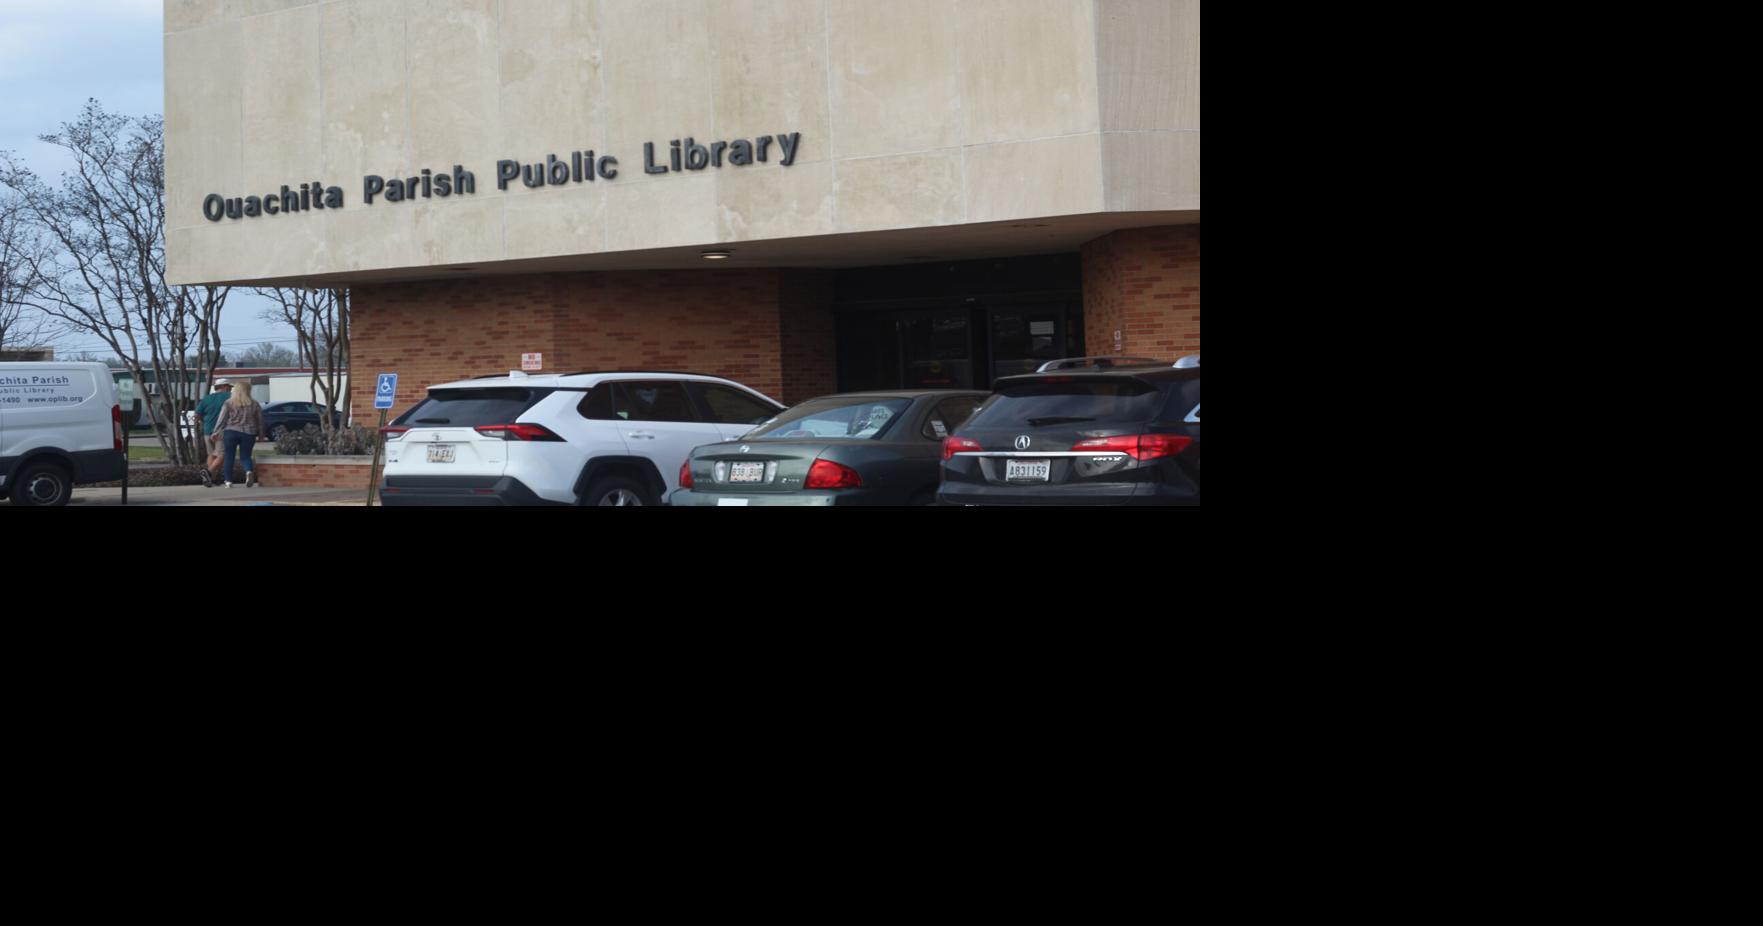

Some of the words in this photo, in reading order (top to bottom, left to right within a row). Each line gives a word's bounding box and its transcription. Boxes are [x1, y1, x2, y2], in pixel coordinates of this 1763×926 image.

[203, 181, 344, 222] Ouachita
[363, 165, 475, 204] Parish
[497, 150, 618, 190] Public
[643, 132, 800, 174] Library
[32, 376, 69, 384] Parish
[24, 386, 54, 394] Library
[27, 395, 83, 403] www.oplib.org
